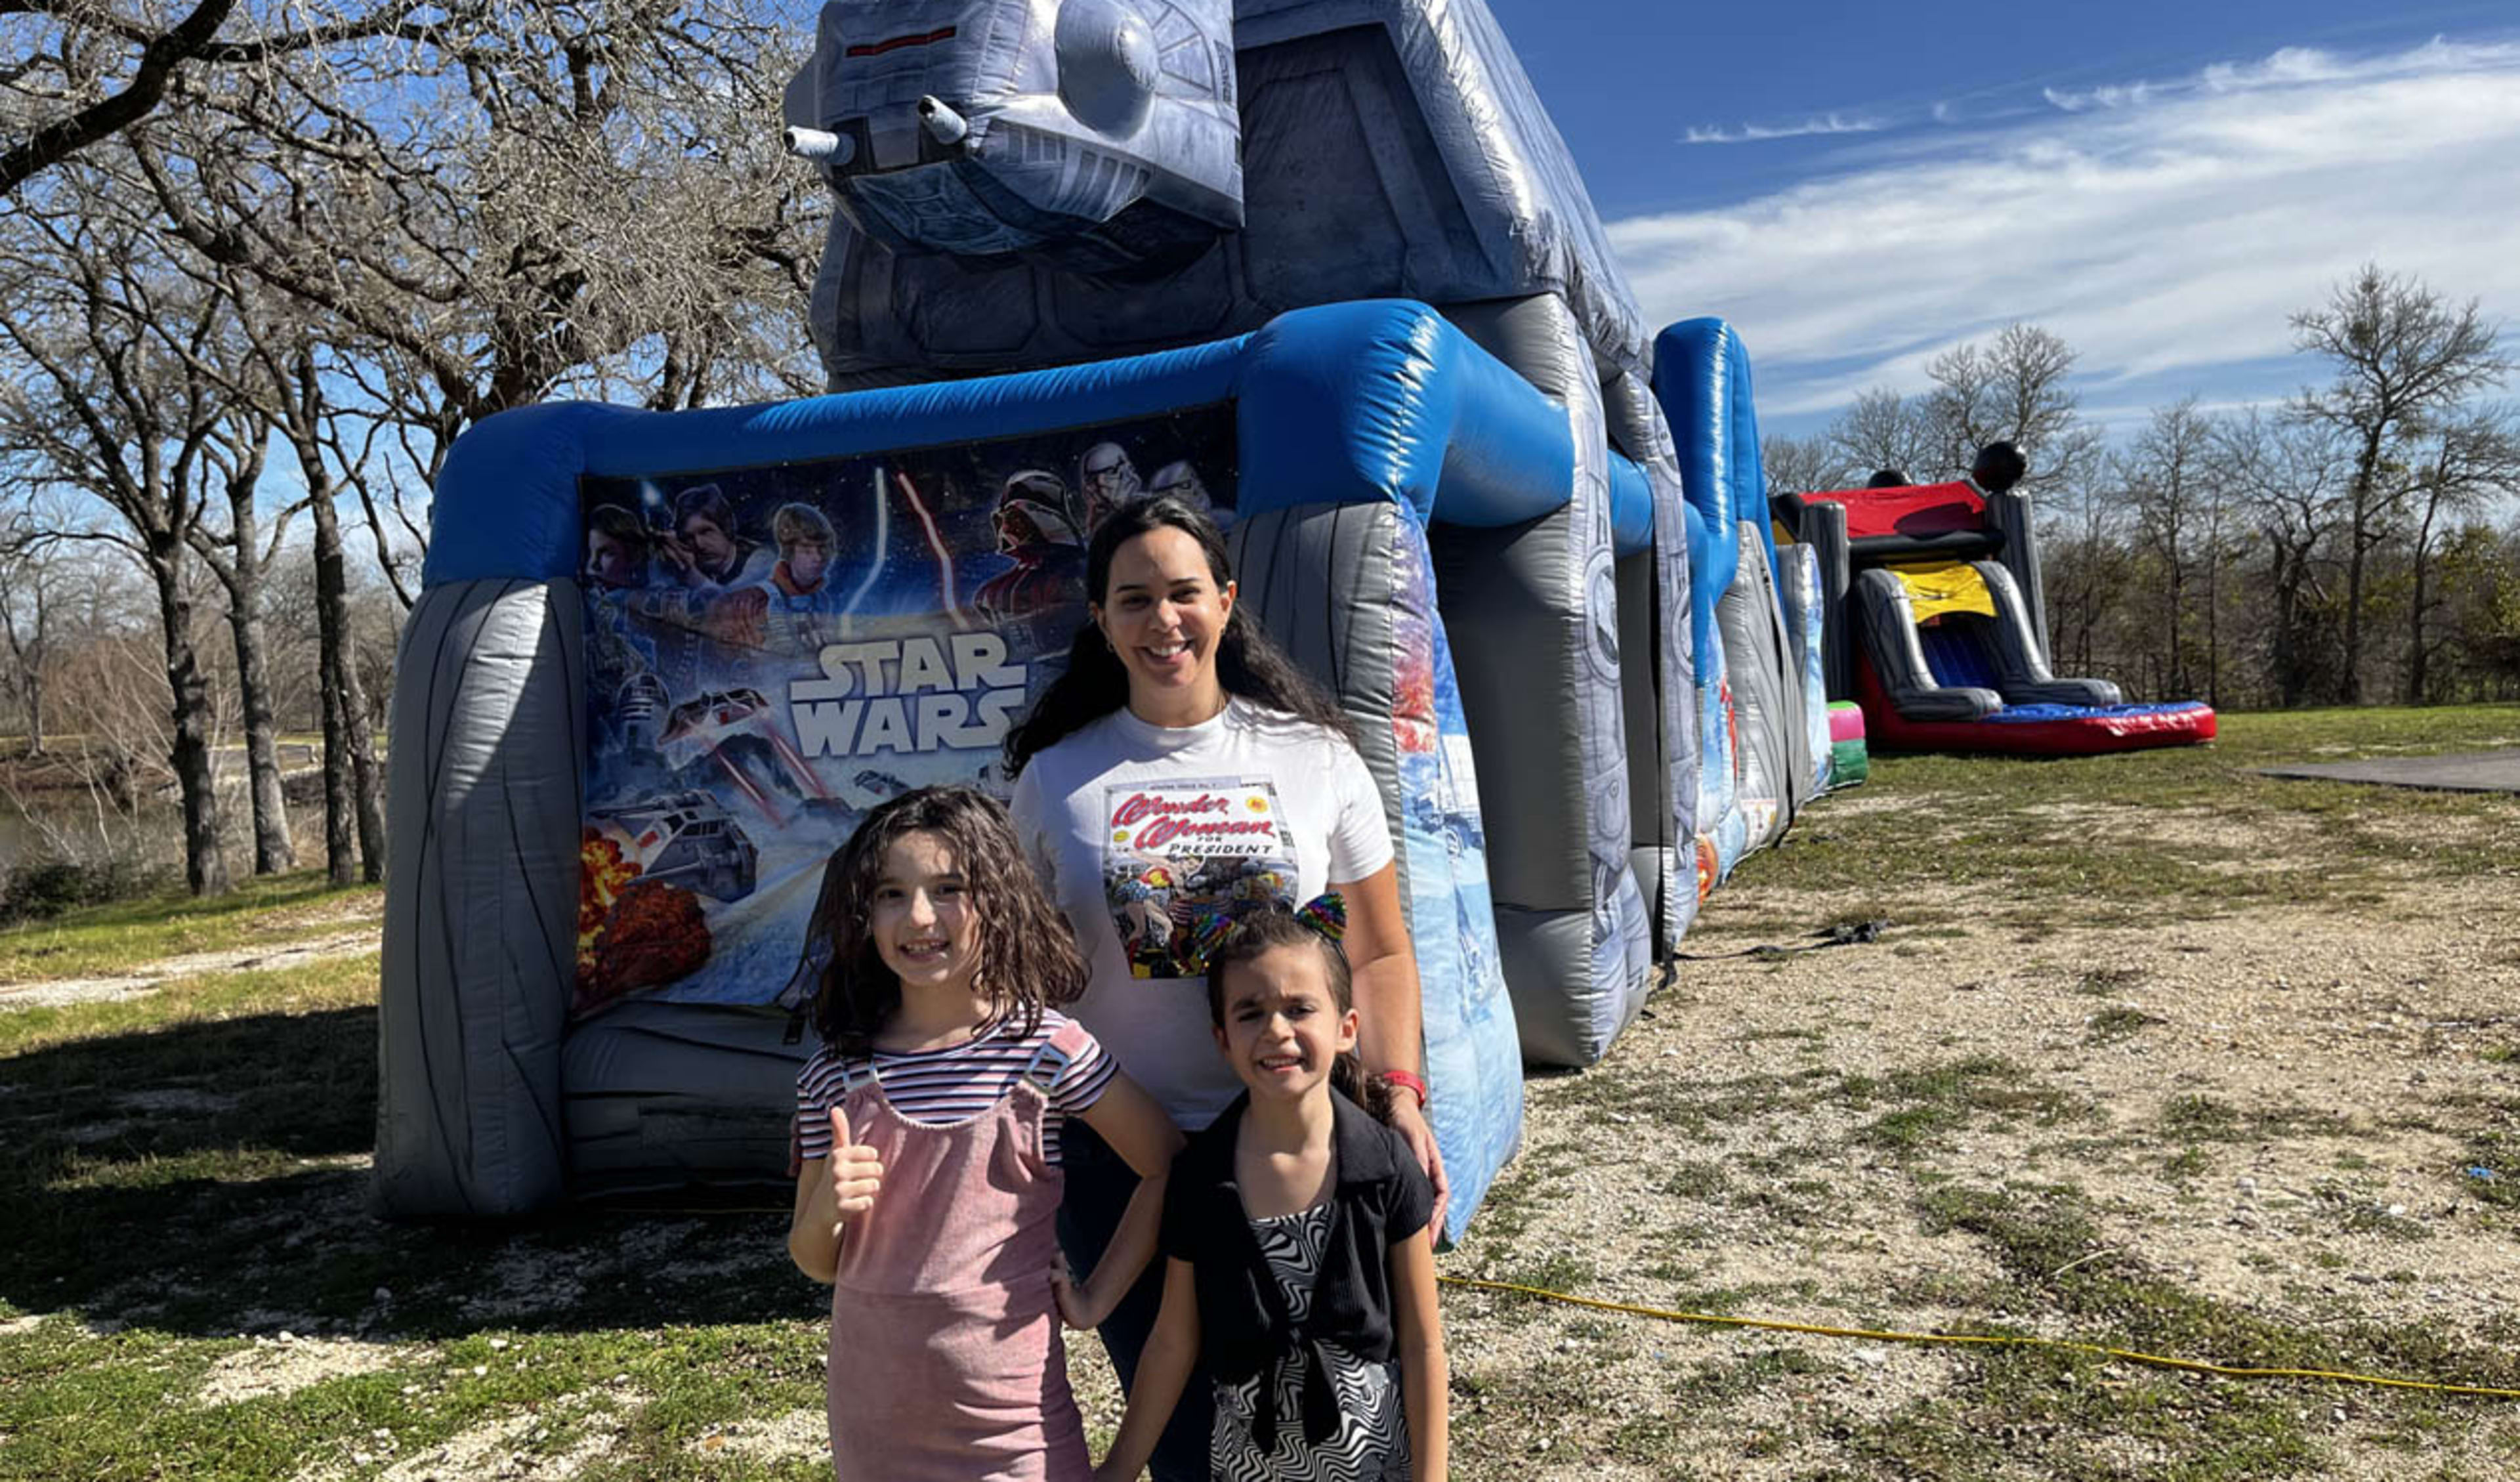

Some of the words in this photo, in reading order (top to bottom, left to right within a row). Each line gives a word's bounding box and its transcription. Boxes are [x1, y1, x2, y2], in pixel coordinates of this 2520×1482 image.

[790, 632, 1027, 700] STAR
[791, 687, 1026, 758] WARS
[1111, 793, 1229, 828] Wonder
[1134, 815, 1276, 849] Woman
[1169, 843, 1274, 854] PRESIDENT
